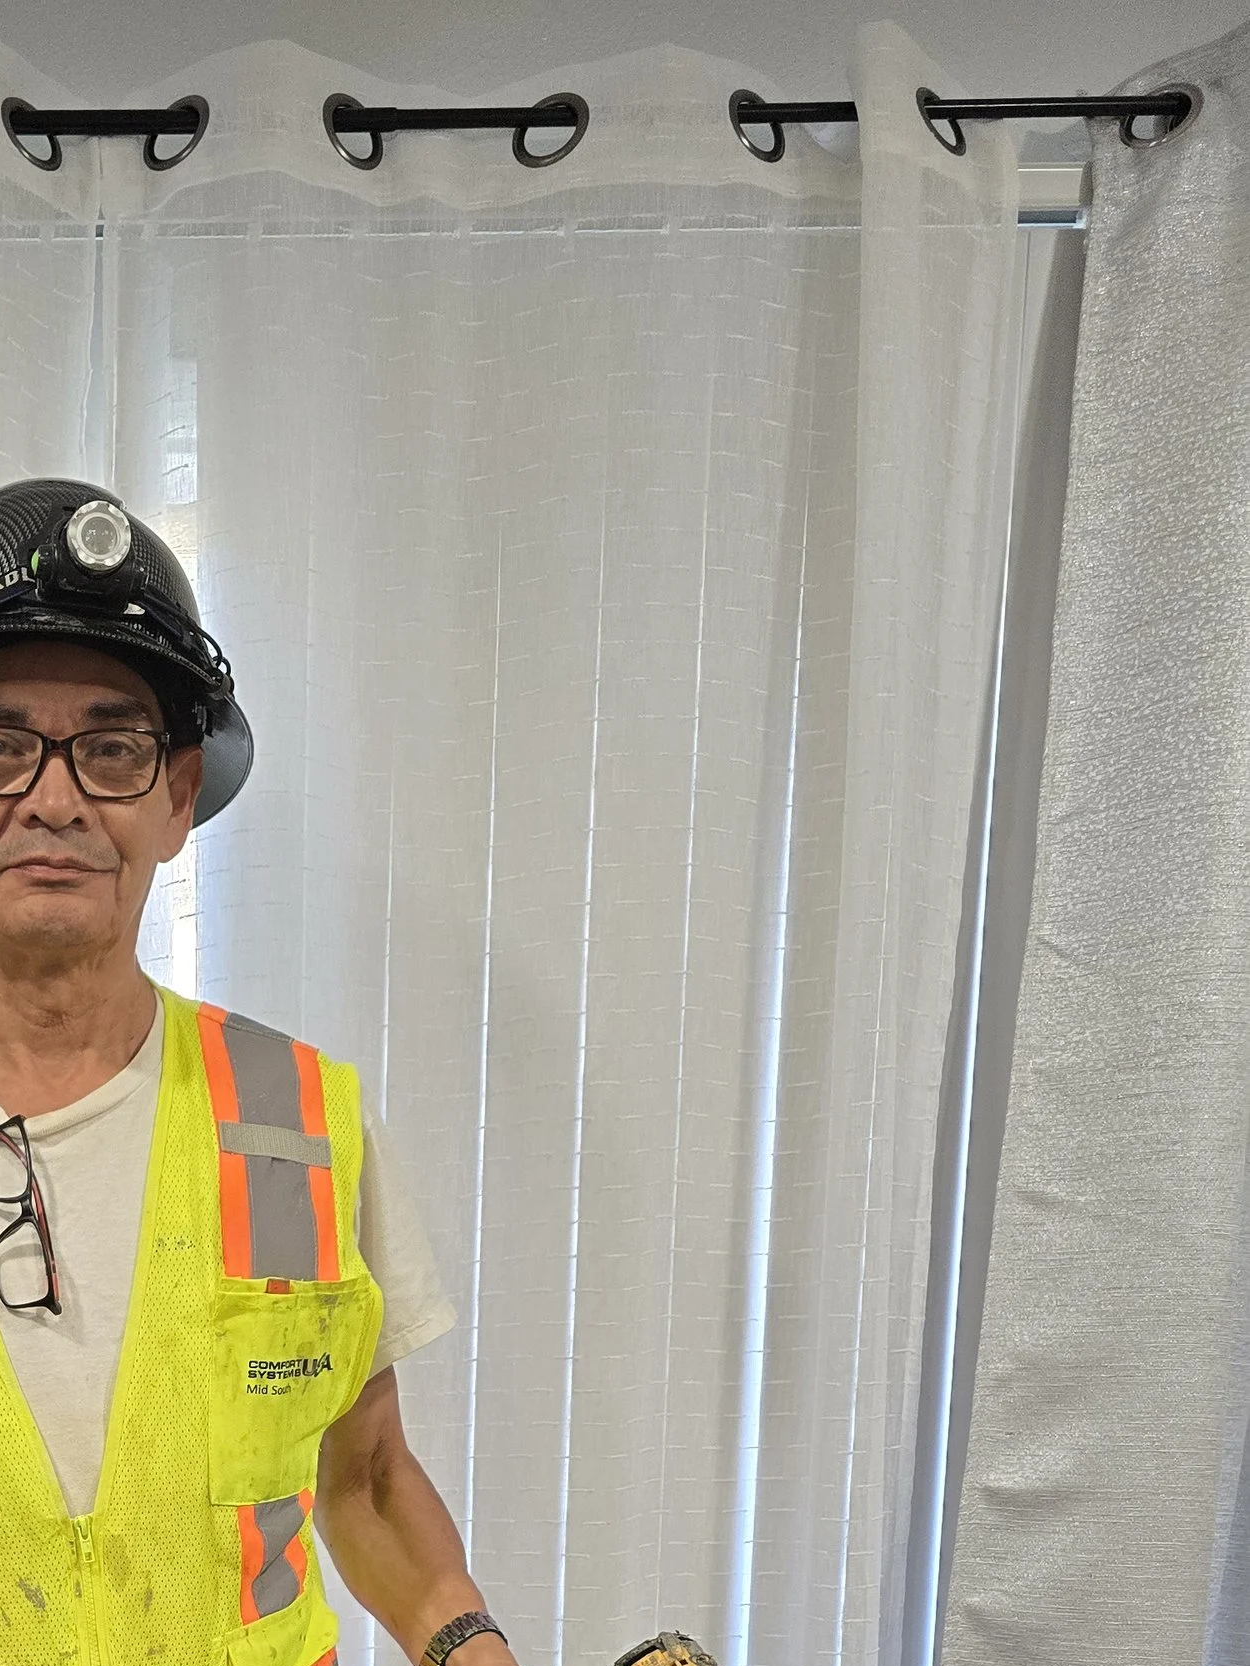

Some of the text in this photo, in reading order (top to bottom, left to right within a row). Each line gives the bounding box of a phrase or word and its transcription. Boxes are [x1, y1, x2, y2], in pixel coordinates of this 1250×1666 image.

[248, 1359, 302, 1370] COMFORT
[247, 1369, 301, 1380] SYSTEMS
[246, 1384, 268, 1395] Mid
